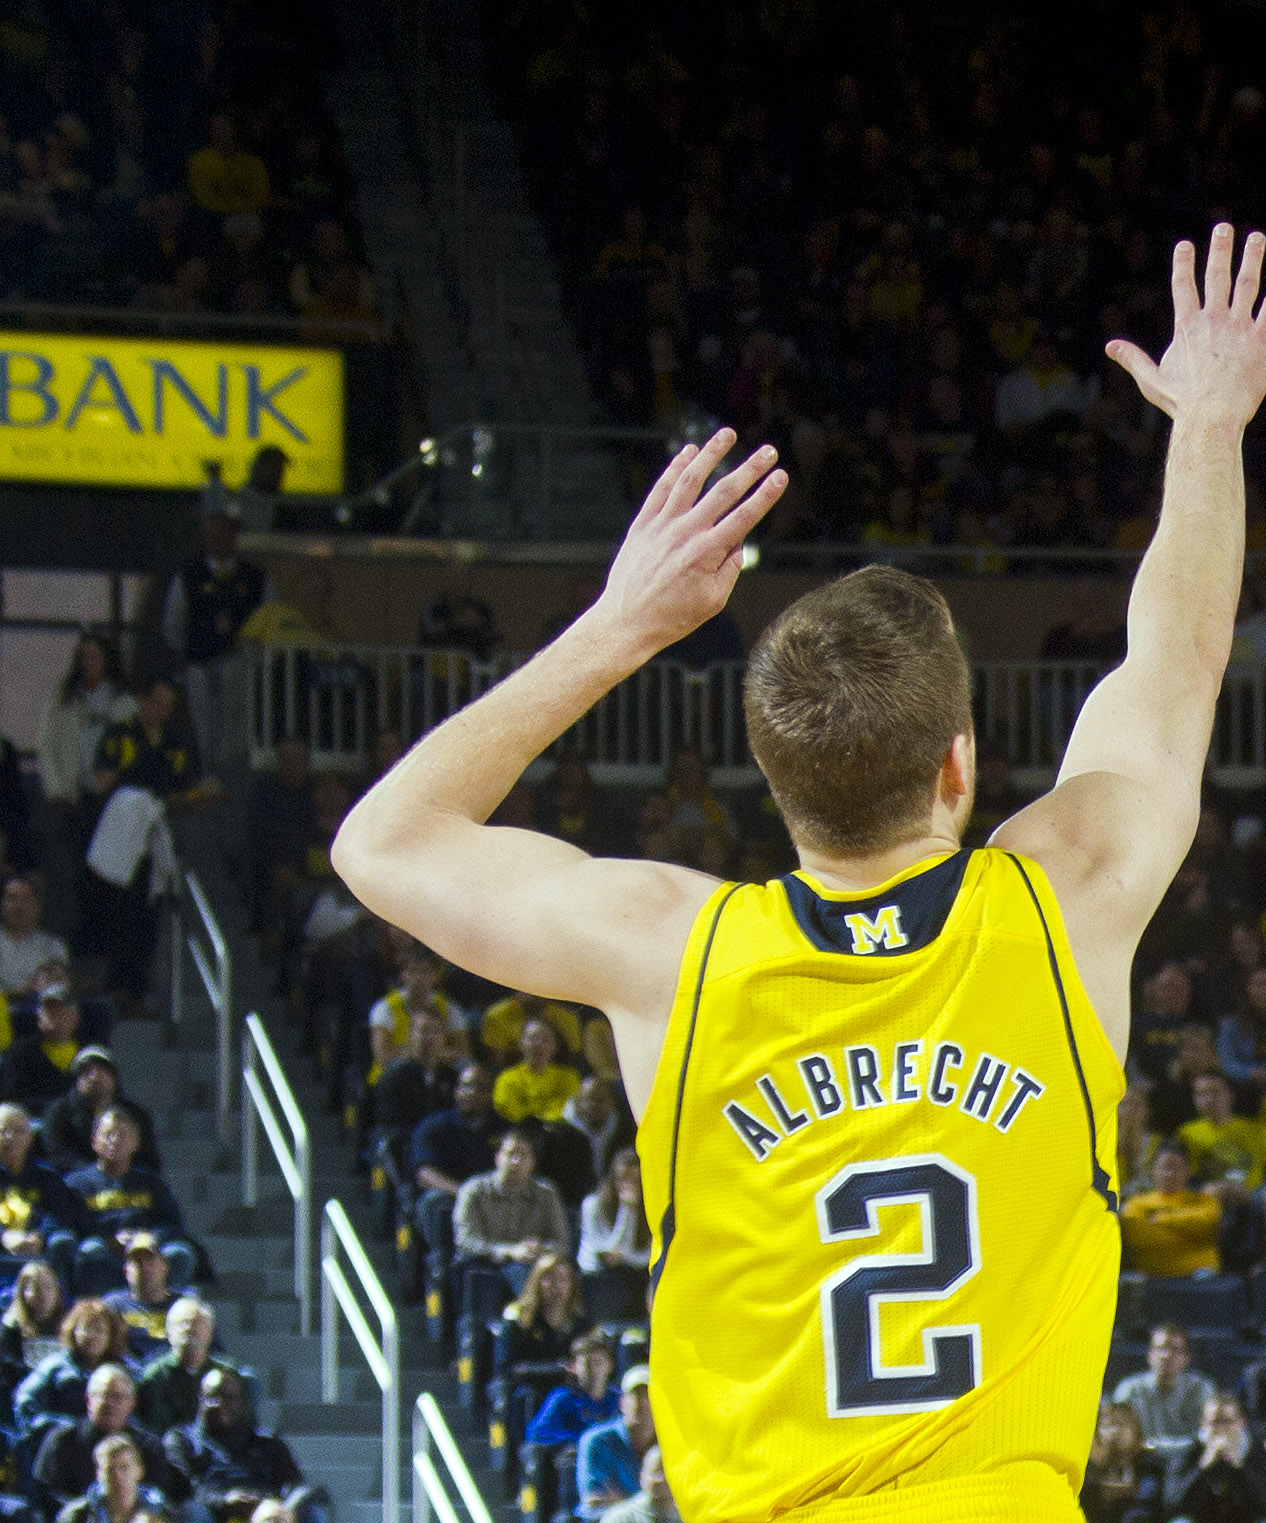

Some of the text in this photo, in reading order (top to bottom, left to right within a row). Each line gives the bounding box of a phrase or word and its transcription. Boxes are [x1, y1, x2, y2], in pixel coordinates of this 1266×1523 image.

[0, 350, 308, 443] BANK
[845, 905, 908, 955] M
[721, 1038, 1045, 1162] ALBRECHT
[815, 1153, 982, 1419] 2
